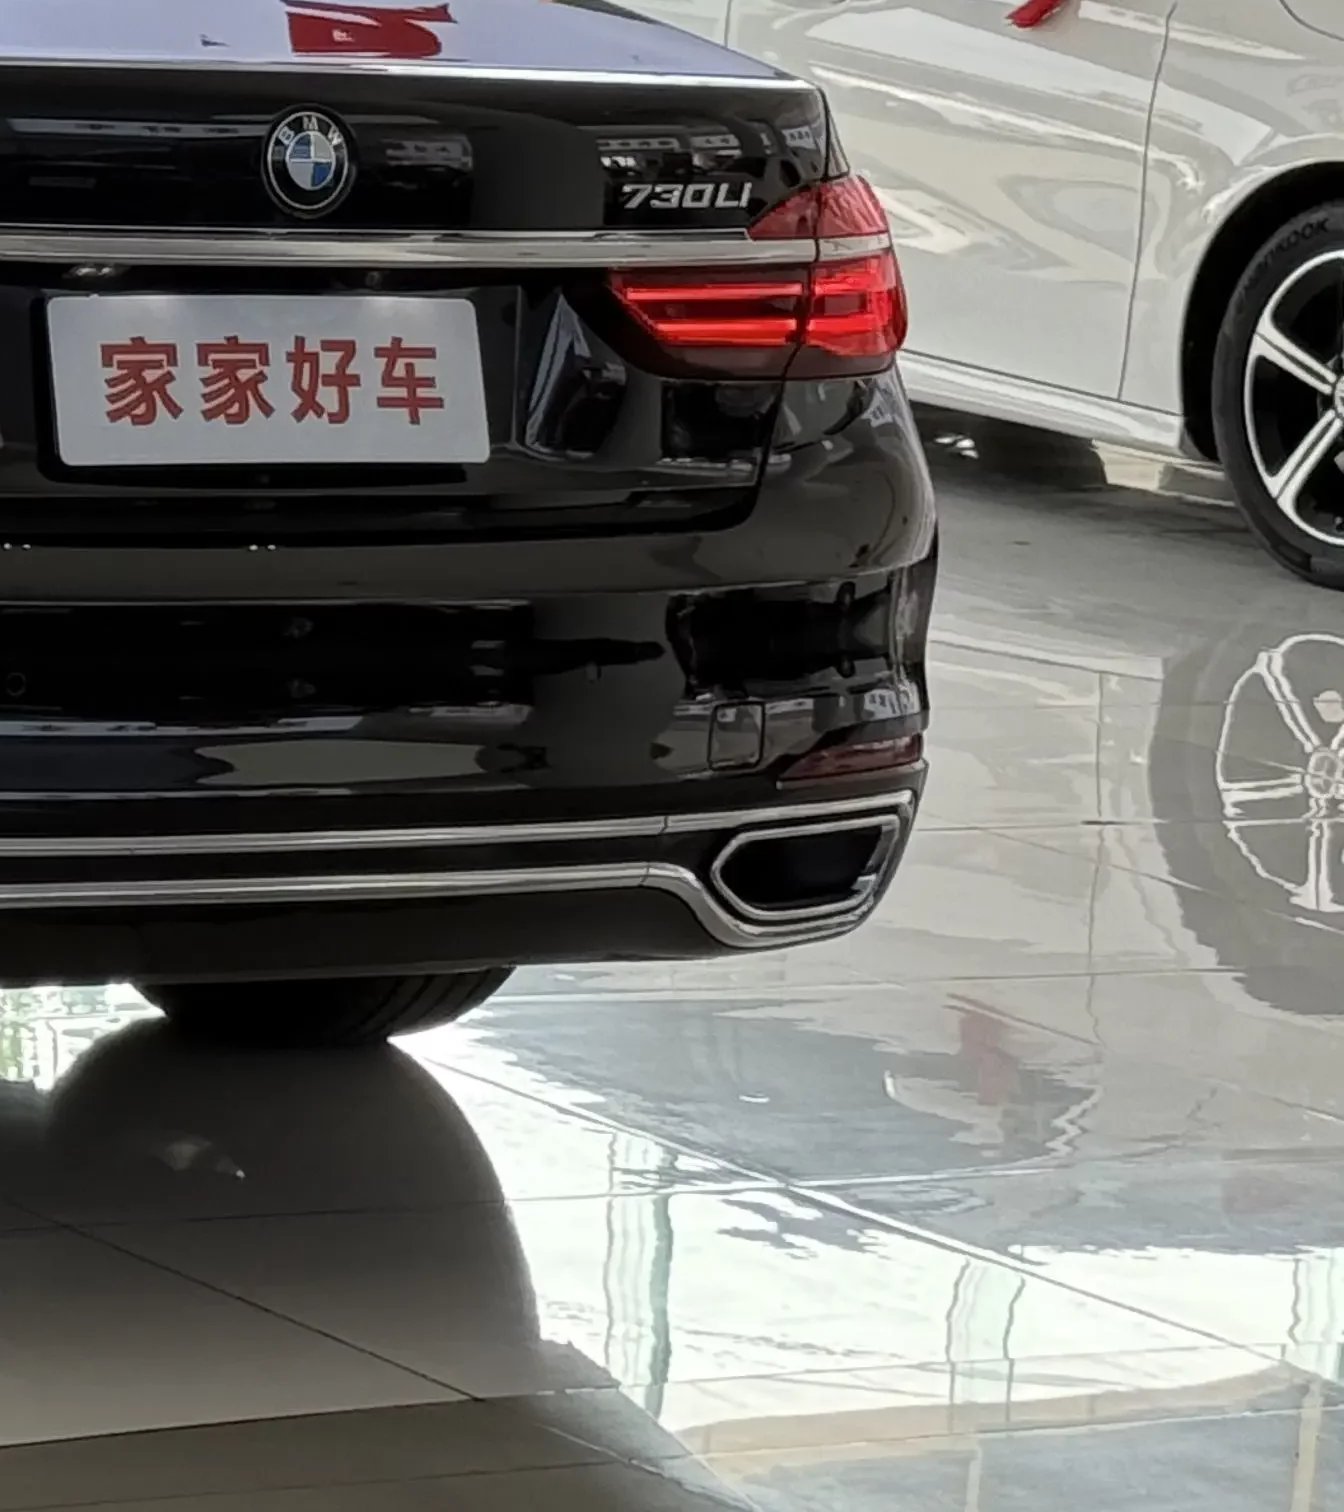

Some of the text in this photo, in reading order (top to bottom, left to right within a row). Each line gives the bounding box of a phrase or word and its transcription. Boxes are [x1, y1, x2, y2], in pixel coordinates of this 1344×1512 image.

[278, 115, 344, 146] BMW
[99, 335, 446, 426] 家家好车
